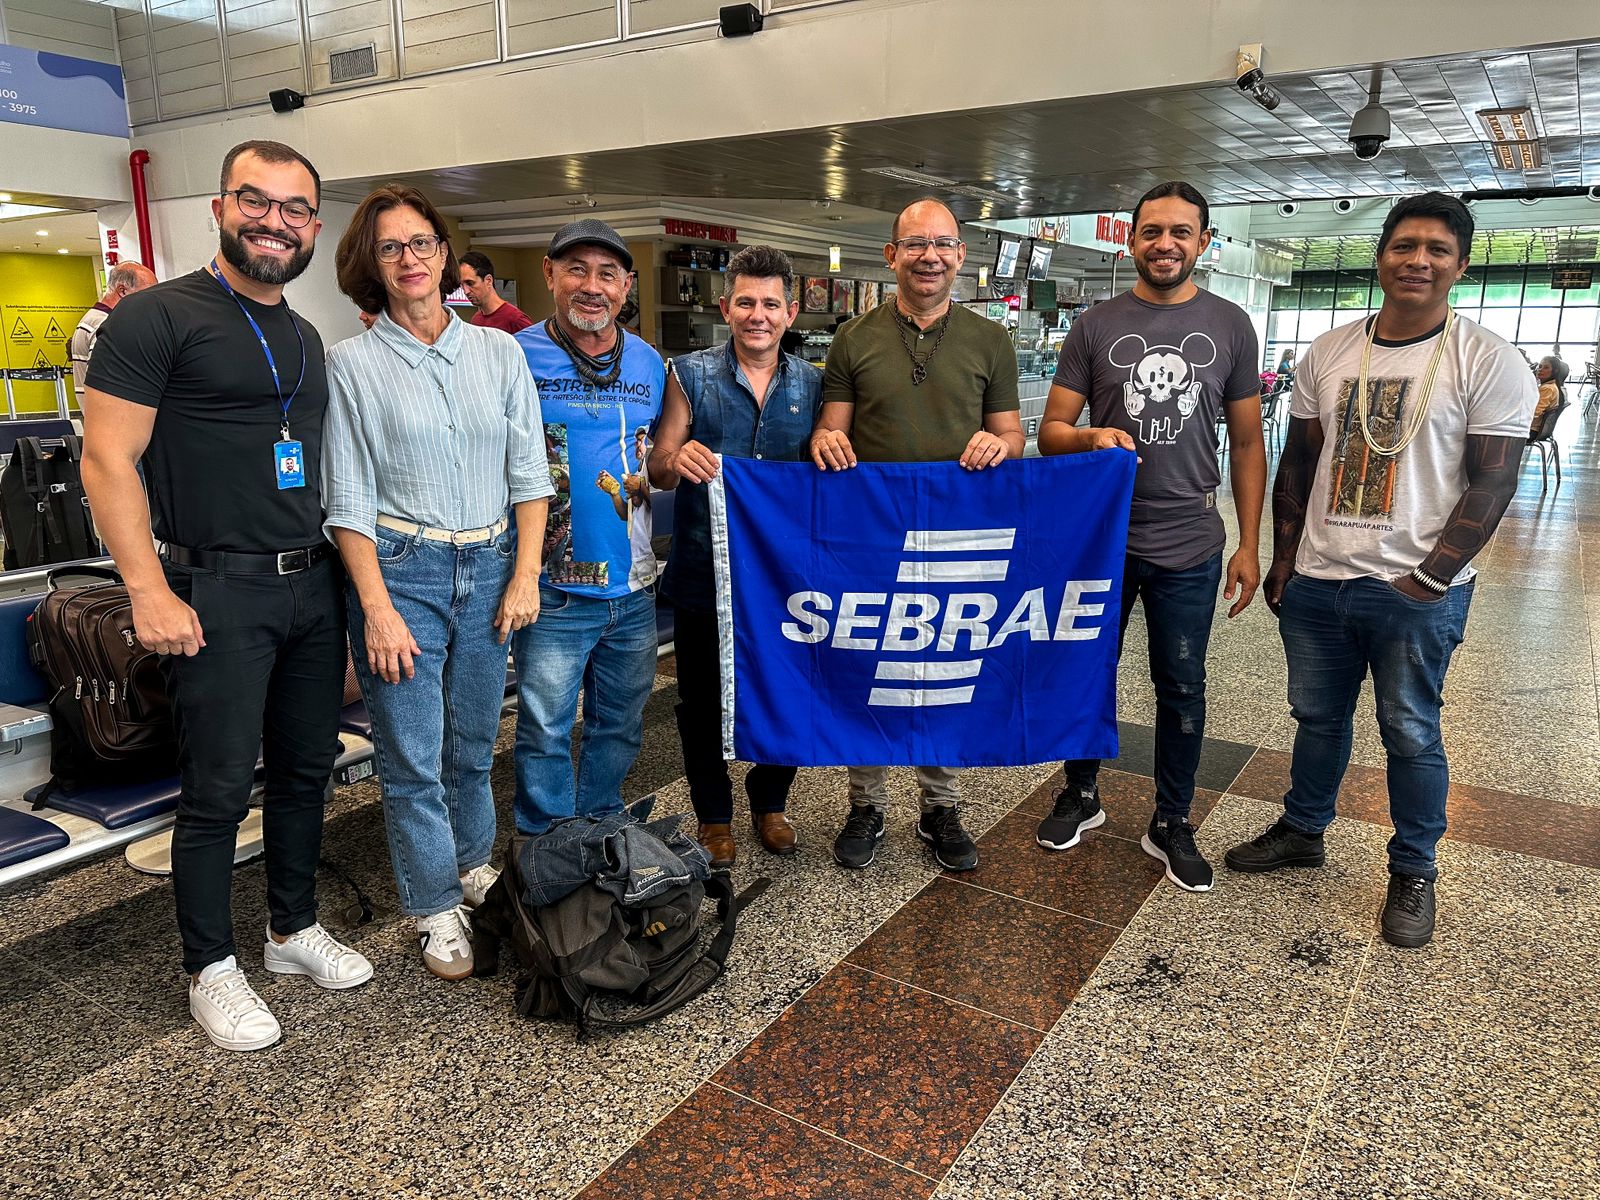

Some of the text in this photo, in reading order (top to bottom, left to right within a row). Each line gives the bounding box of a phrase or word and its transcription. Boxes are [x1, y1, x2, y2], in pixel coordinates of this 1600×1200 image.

[8, 102, 37, 115] 3975
[600, 380, 651, 398] RAMOS
[553, 393, 584, 401] ARTESÃO
[781, 579, 1112, 651] SEBRAE
